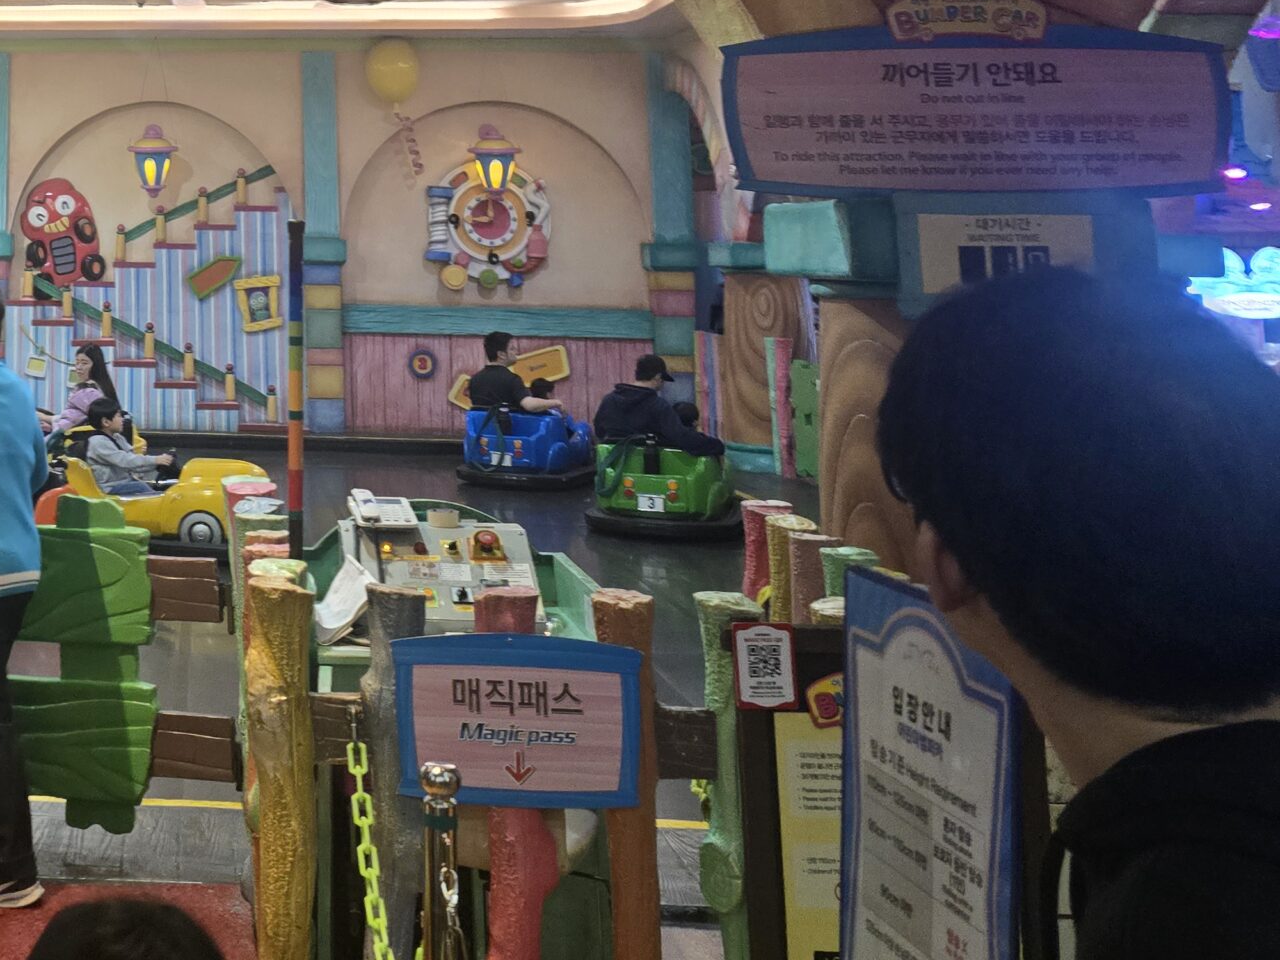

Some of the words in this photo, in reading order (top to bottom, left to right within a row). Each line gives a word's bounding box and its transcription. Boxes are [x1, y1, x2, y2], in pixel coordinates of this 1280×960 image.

[881, 62, 980, 87] 끼어들기
[986, 61, 1063, 87] 안돼요
[920, 93, 939, 103] Do
[941, 93, 964, 103] not
[870, 114, 883, 126] 서
[773, 151, 789, 162] To
[791, 151, 815, 162] ride
[817, 151, 840, 162] this
[647, 496, 655, 509] 3
[452, 677, 584, 717] 매직패스
[892, 685, 951, 742] 입장안내
[460, 722, 524, 745] Magic
[526, 730, 577, 746] pass
